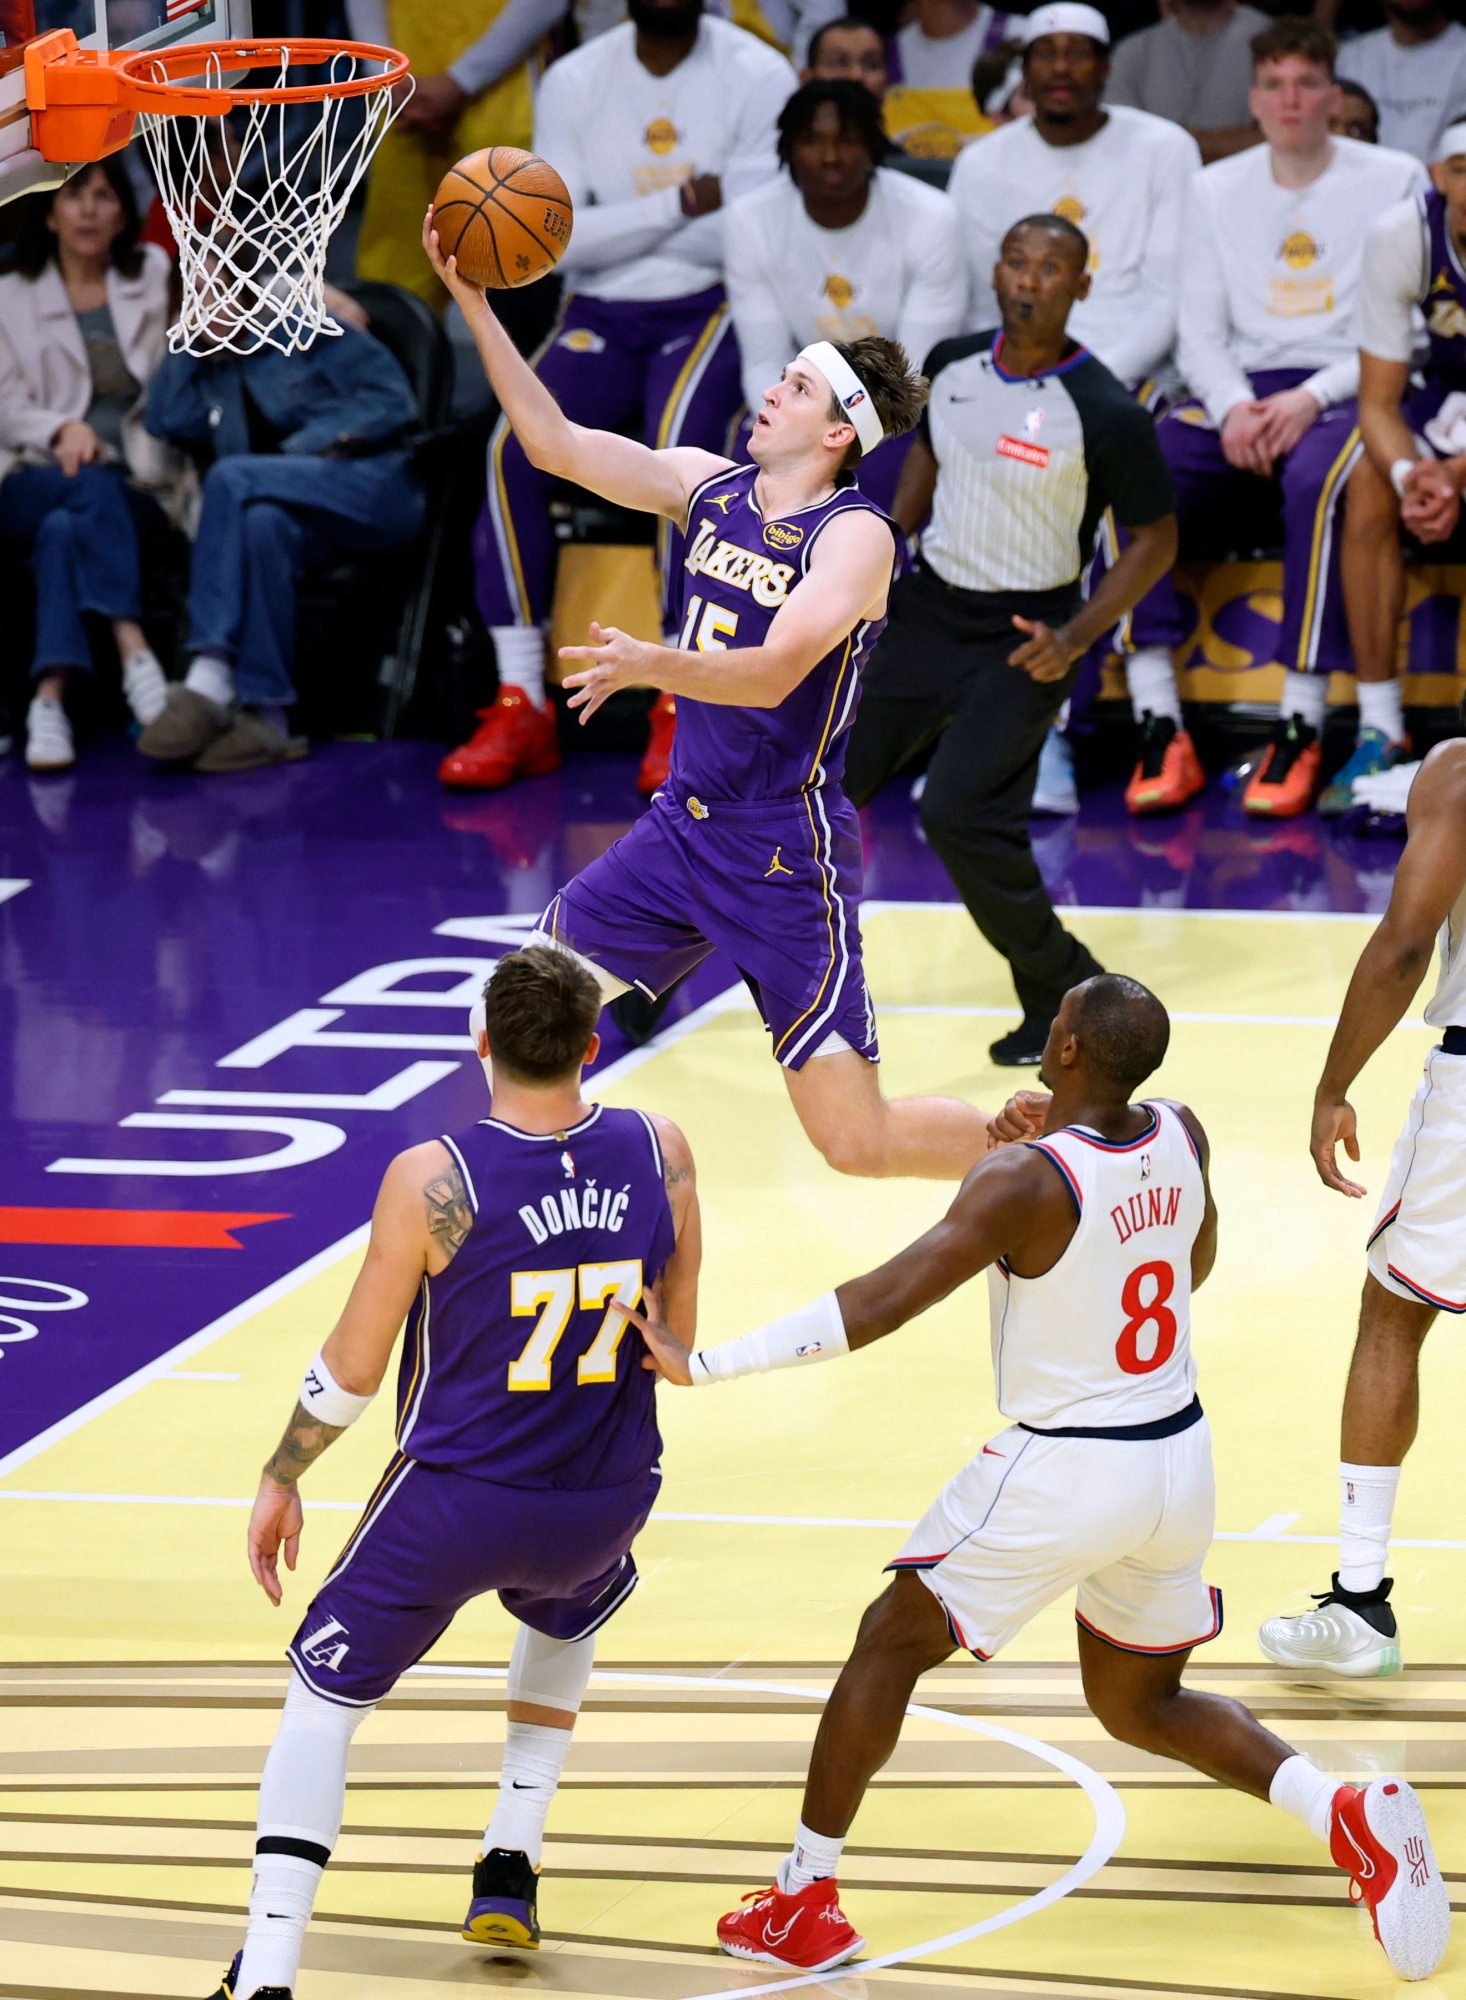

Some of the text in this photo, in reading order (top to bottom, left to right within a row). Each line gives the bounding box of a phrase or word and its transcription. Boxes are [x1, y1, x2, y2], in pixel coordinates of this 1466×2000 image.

[684, 518, 796, 607] LAKERS
[768, 525, 801, 544] bibigo
[679, 595, 739, 652] 15
[518, 1178, 632, 1245] DONČIĆ
[1110, 1187, 1182, 1245] DUNN
[508, 1259, 643, 1392] 77
[1115, 1260, 1177, 1375] 8
[300, 1614, 350, 1673] LA
